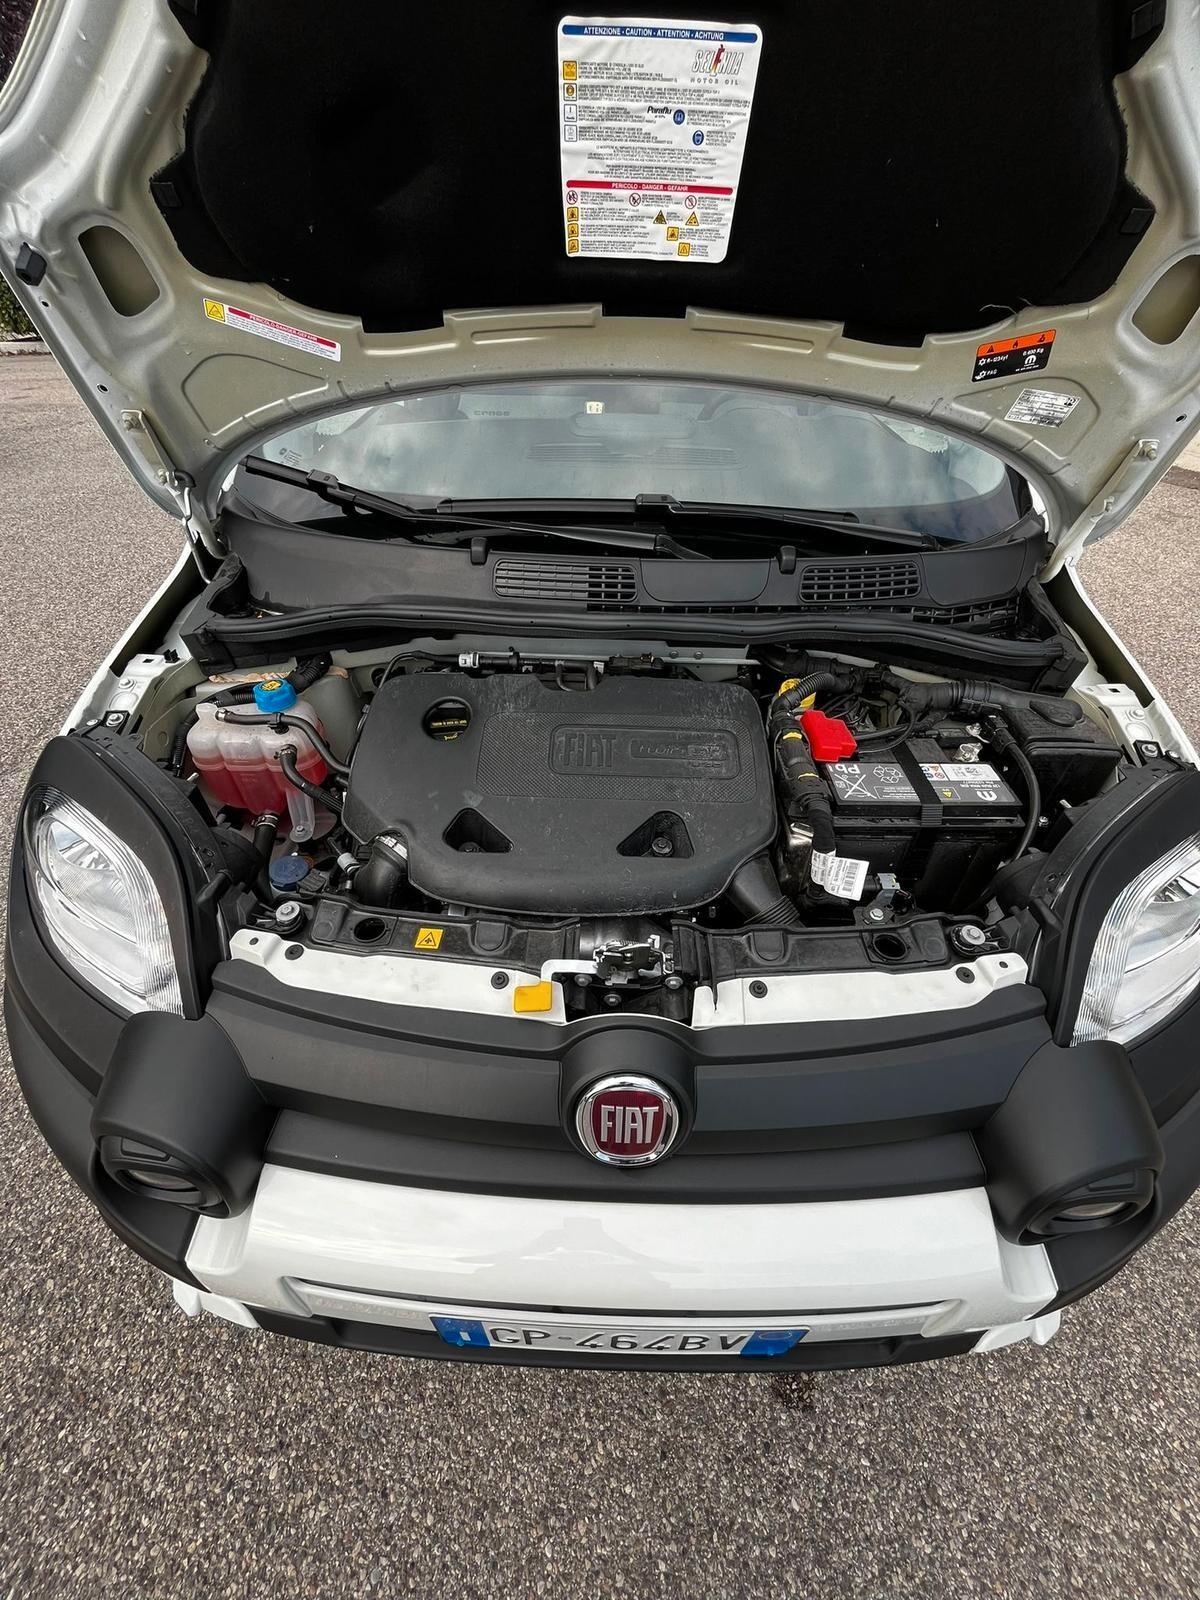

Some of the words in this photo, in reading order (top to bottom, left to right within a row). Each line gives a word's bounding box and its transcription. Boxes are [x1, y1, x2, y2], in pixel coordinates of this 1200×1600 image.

[584, 27, 621, 35] ATTENZIONE
[624, 28, 653, 36] CAUTION
[657, 29, 690, 38] ATTENTION
[694, 31, 724, 40] ACHTUNG
[646, 105, 673, 115] Paraflu
[611, 182, 638, 190] PERICOLO
[641, 183, 664, 191] DANGER
[667, 184, 689, 192] GEFAHR
[563, 732, 617, 768] FIAT
[836, 763, 862, 774] Pb
[600, 1104, 660, 1144] FIAT
